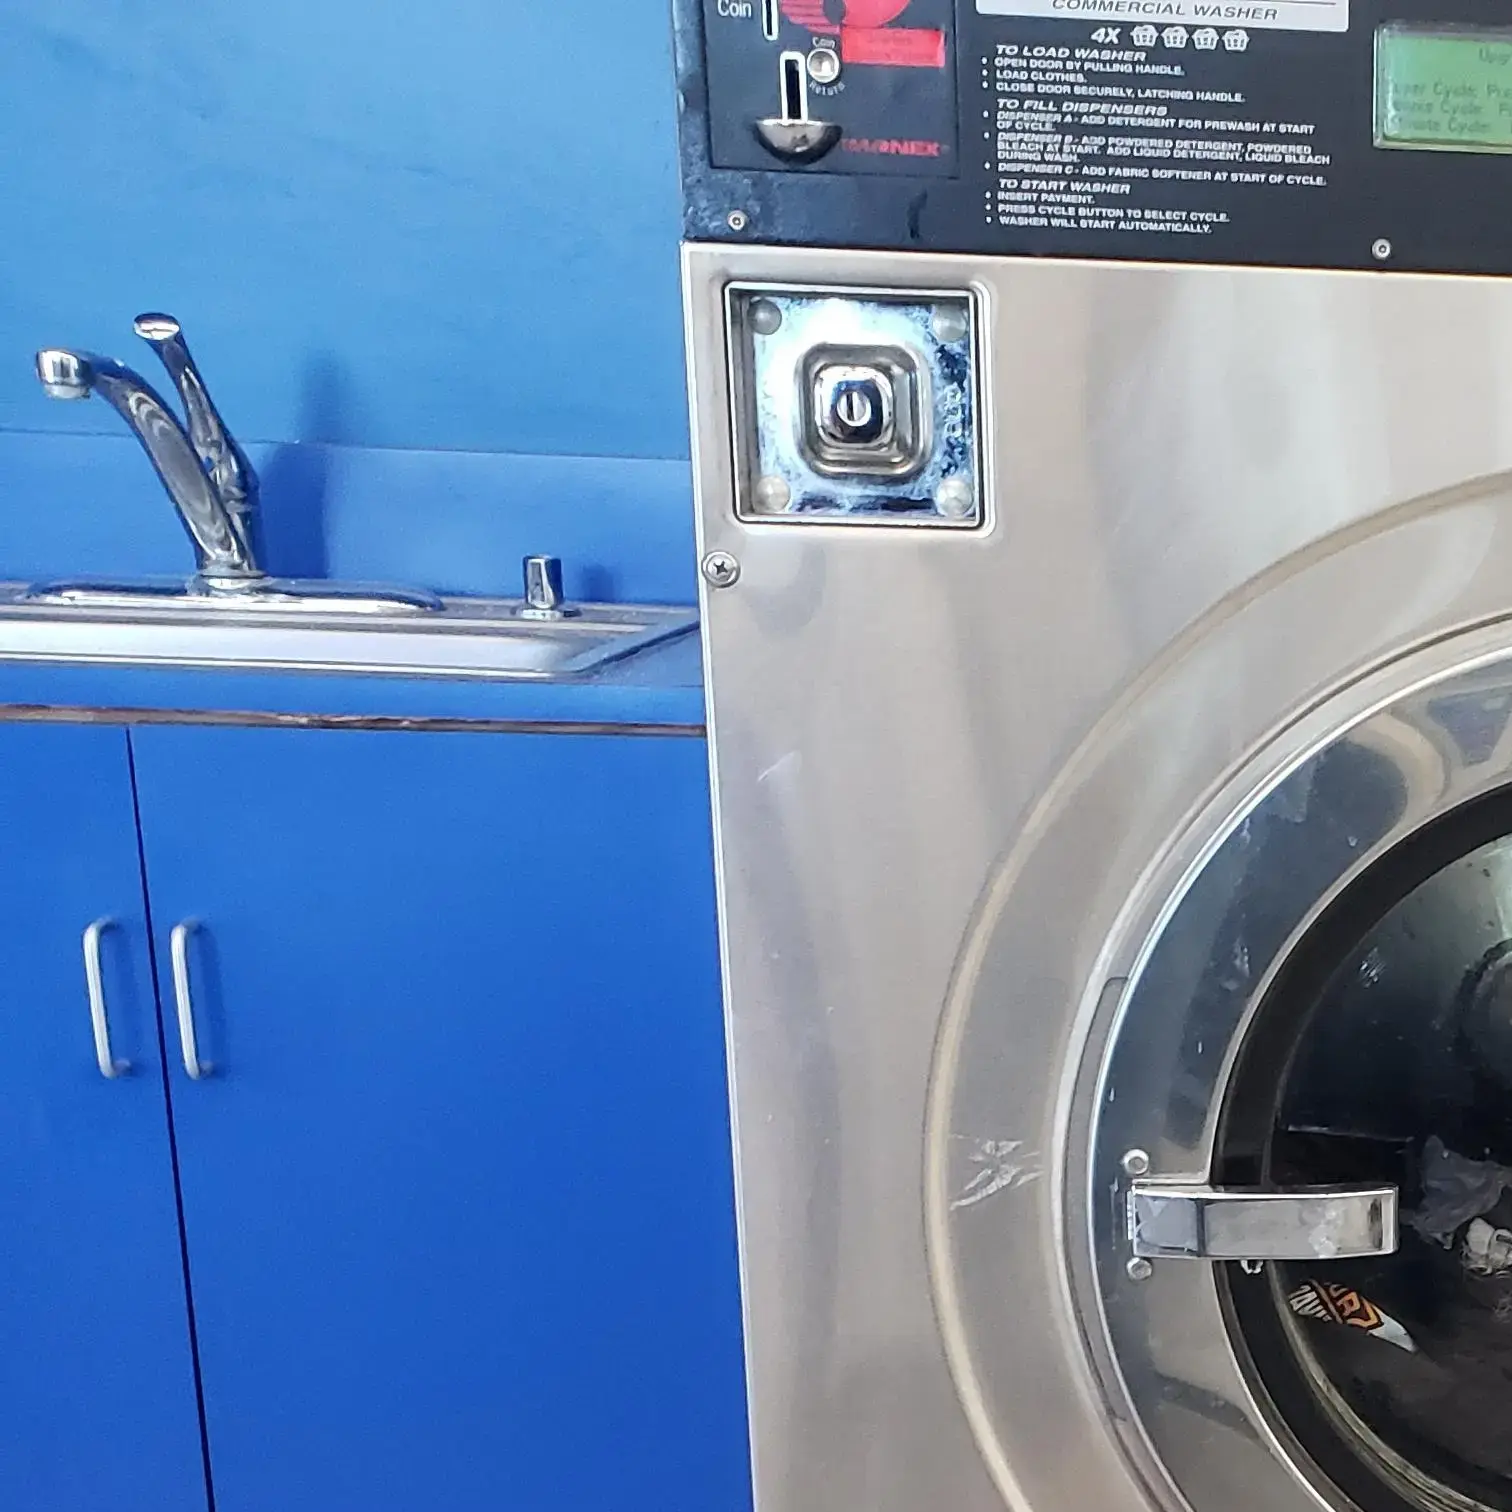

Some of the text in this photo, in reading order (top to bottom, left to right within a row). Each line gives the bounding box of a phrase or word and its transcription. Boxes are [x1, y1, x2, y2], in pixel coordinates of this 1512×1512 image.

[717, 0, 753, 18] Coin
[1052, 0, 1279, 21] COMMERCIAL WASHER
[1091, 27, 1121, 44] 4X
[996, 45, 1147, 62] TO LOAD WASHER
[994, 57, 1027, 68] OPEN
[1029, 58, 1063, 70] DOOR
[1066, 60, 1081, 71] BY
[1084, 61, 1132, 73] PULLING
[996, 69, 1028, 81] LOAD
[996, 81, 1035, 93] CLOSE
[1037, 83, 1070, 94] DOOR
[1138, 88, 1193, 101] LATCHING
[997, 99, 1168, 117] TO FILL DISPENSERS
[1081, 115, 1105, 125] ADD
[1108, 116, 1176, 128] DETERGENT
[1178, 119, 1202, 129] FOR
[1204, 121, 1260, 132] PREWASH
[1263, 123, 1276, 133] AT
[1279, 124, 1315, 134] START
[997, 141, 1043, 151] BLEACH
[1046, 143, 1061, 152] AT
[1107, 146, 1130, 156] ADD
[1133, 147, 1171, 158] LIQUID
[1245, 152, 1282, 163] LIQUID
[1285, 155, 1330, 165] BLEACH
[1082, 136, 1106, 145] ADD
[1108, 136, 1173, 148] POWDERED
[1247, 143, 1311, 155] POWDERED
[998, 151, 1041, 161] DURING
[1082, 166, 1106, 176] ADD
[1108, 167, 1149, 178] FABRIC
[1214, 172, 1228, 181] AT
[1231, 172, 1265, 183] START
[1268, 174, 1284, 184] OF
[999, 178, 1131, 195] TO START WASHER
[998, 191, 1039, 201] INSERT
[998, 204, 1035, 214] PRESS
[1038, 205, 1075, 216] CYCLE
[1078, 207, 1124, 218] BUTTON
[1127, 209, 1141, 219] TO
[1144, 210, 1187, 221] SELECT
[999, 216, 1048, 226] WASHER
[1051, 218, 1077, 228] WILL
[1080, 219, 1116, 230] START
